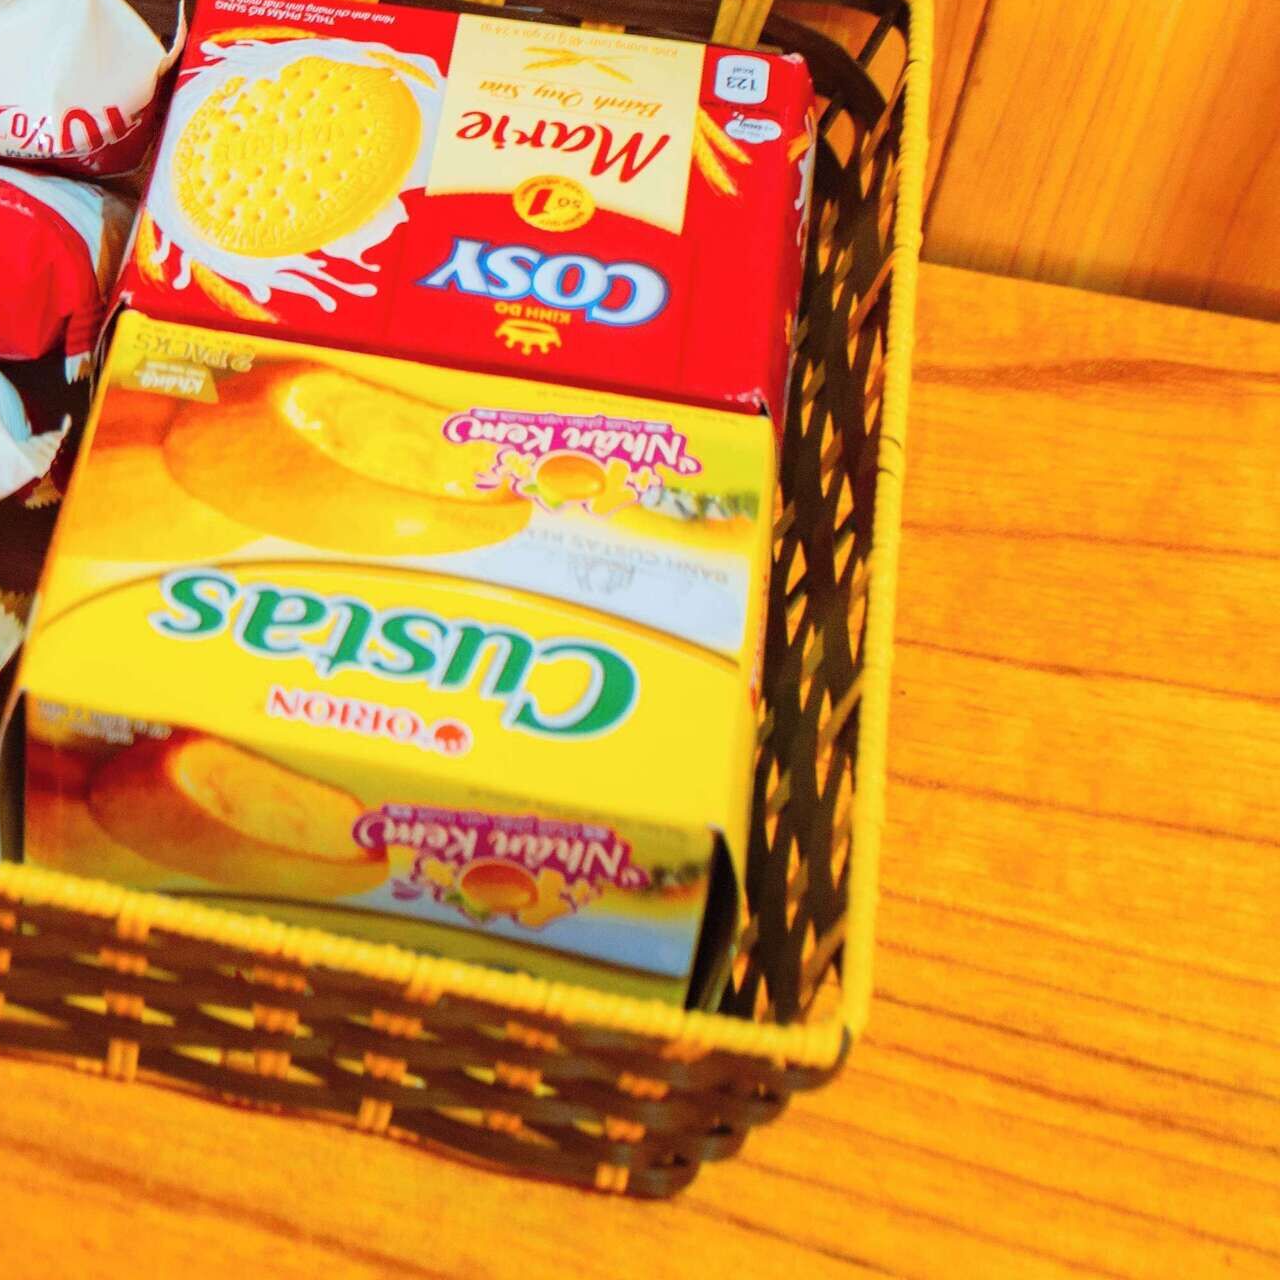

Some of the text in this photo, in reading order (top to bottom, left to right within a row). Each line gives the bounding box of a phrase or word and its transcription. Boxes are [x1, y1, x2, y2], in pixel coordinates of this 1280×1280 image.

[592, 95, 664, 120] Bánh
[725, 74, 758, 93] 123
[455, 110, 672, 184] Marie
[415, 235, 670, 327] COSY
[525, 308, 572, 324] KINH
[448, 416, 682, 466] Nhân Kem
[156, 574, 639, 738] Custas
[271, 688, 421, 737] ORION
[487, 826, 627, 877] Nhân
